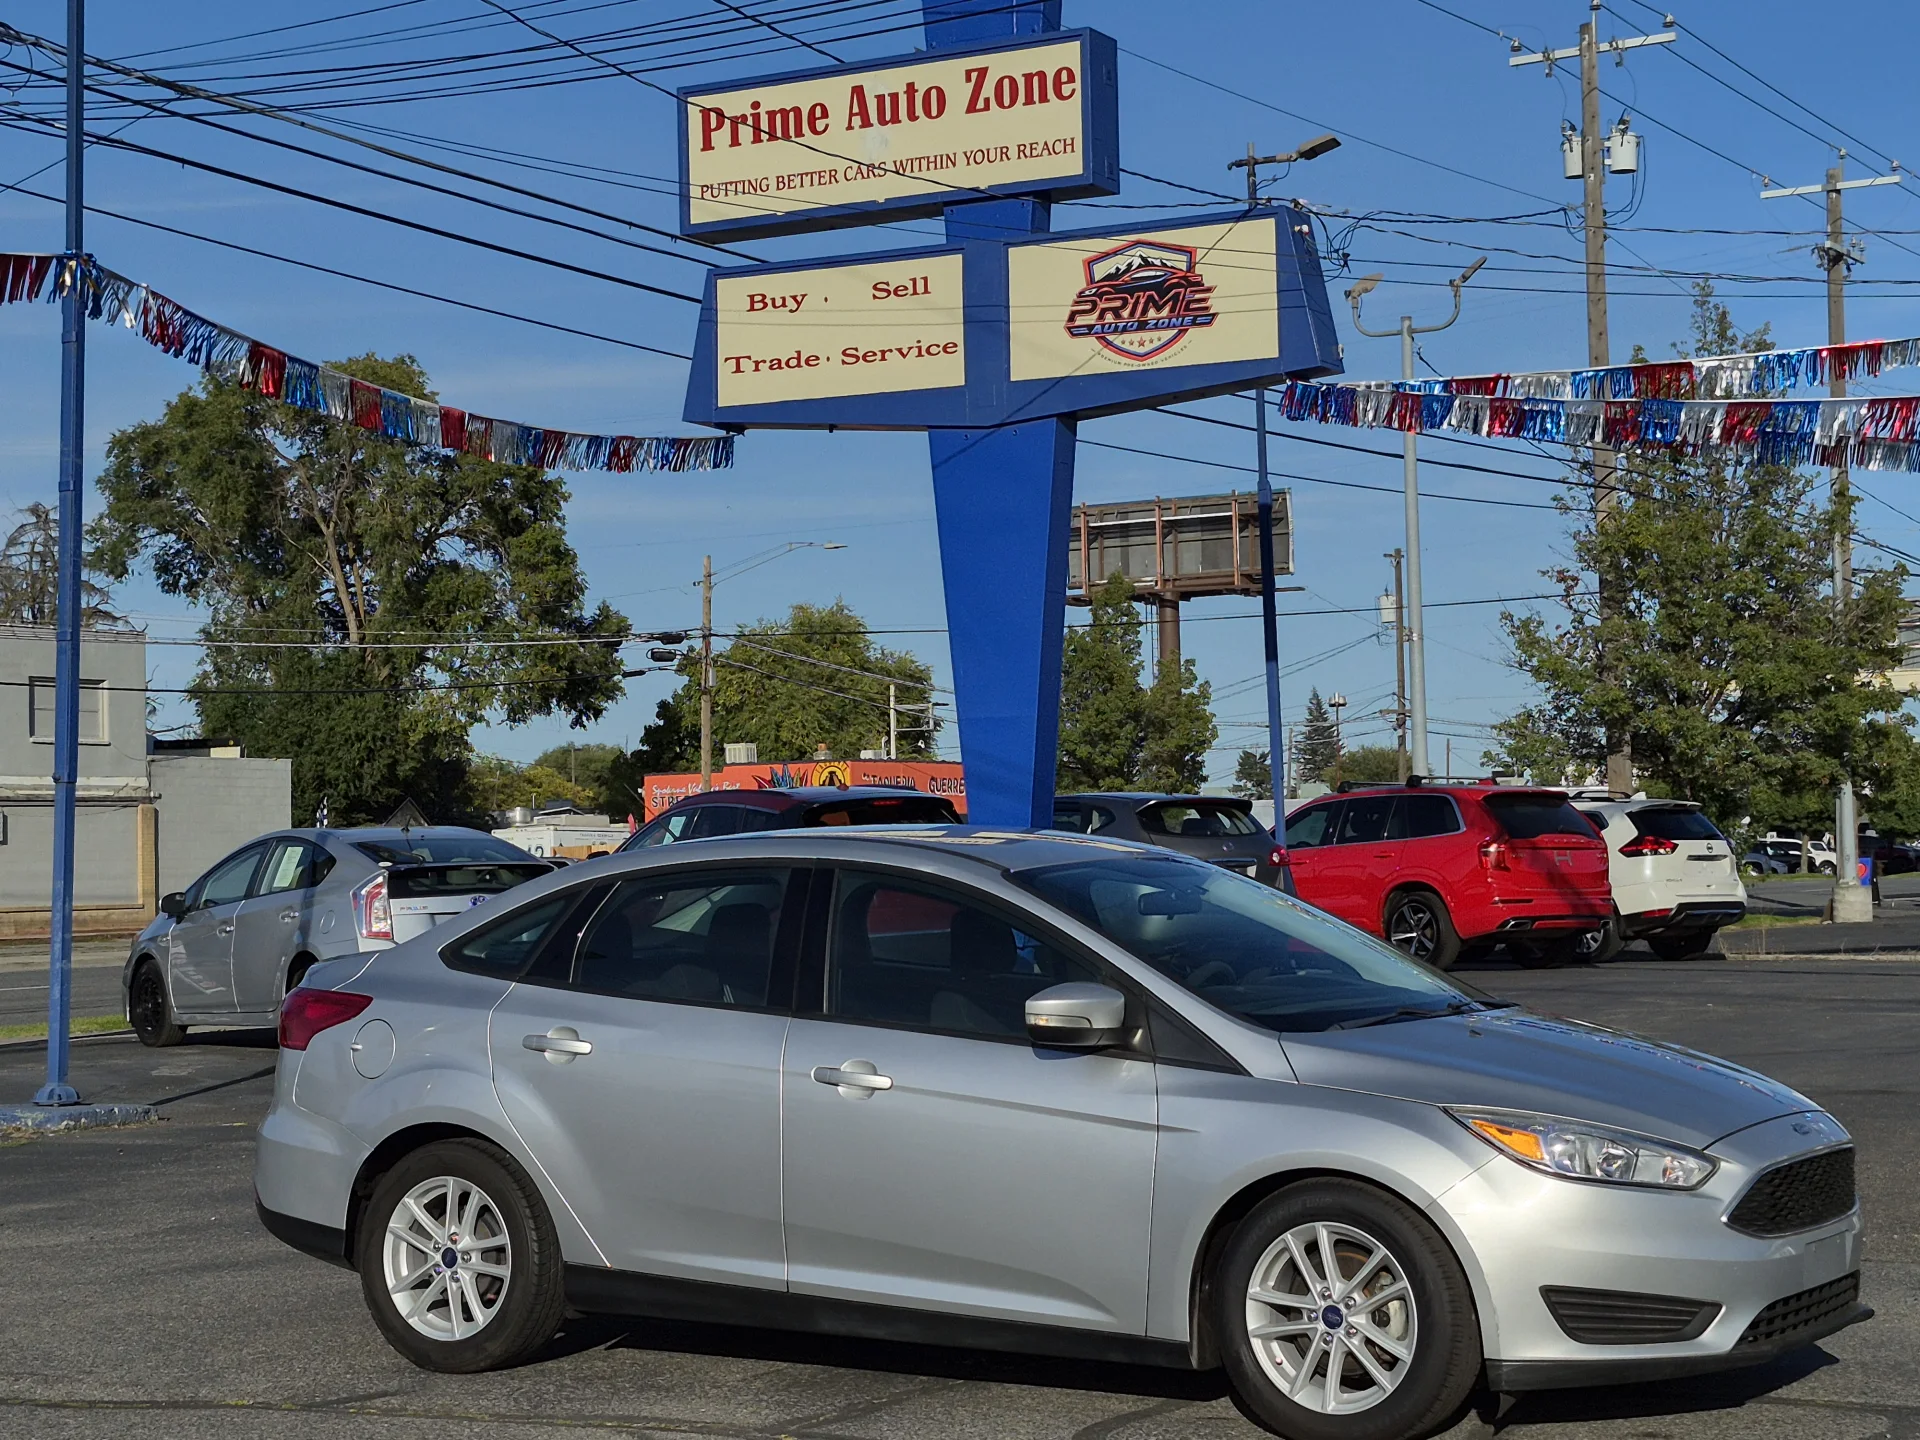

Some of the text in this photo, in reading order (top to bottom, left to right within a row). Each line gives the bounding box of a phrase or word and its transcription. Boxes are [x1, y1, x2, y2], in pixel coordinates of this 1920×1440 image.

[699, 65, 1076, 152] Prime Auto Zone
[699, 136, 1076, 200] PUTTING BETTER CARS WITHIN YOUR REACH
[746, 276, 931, 313] Buy Sell
[1065, 285, 1217, 325] PRIME
[1091, 316, 1194, 334] AUTO ZONE
[724, 339, 958, 374] Trade Service
